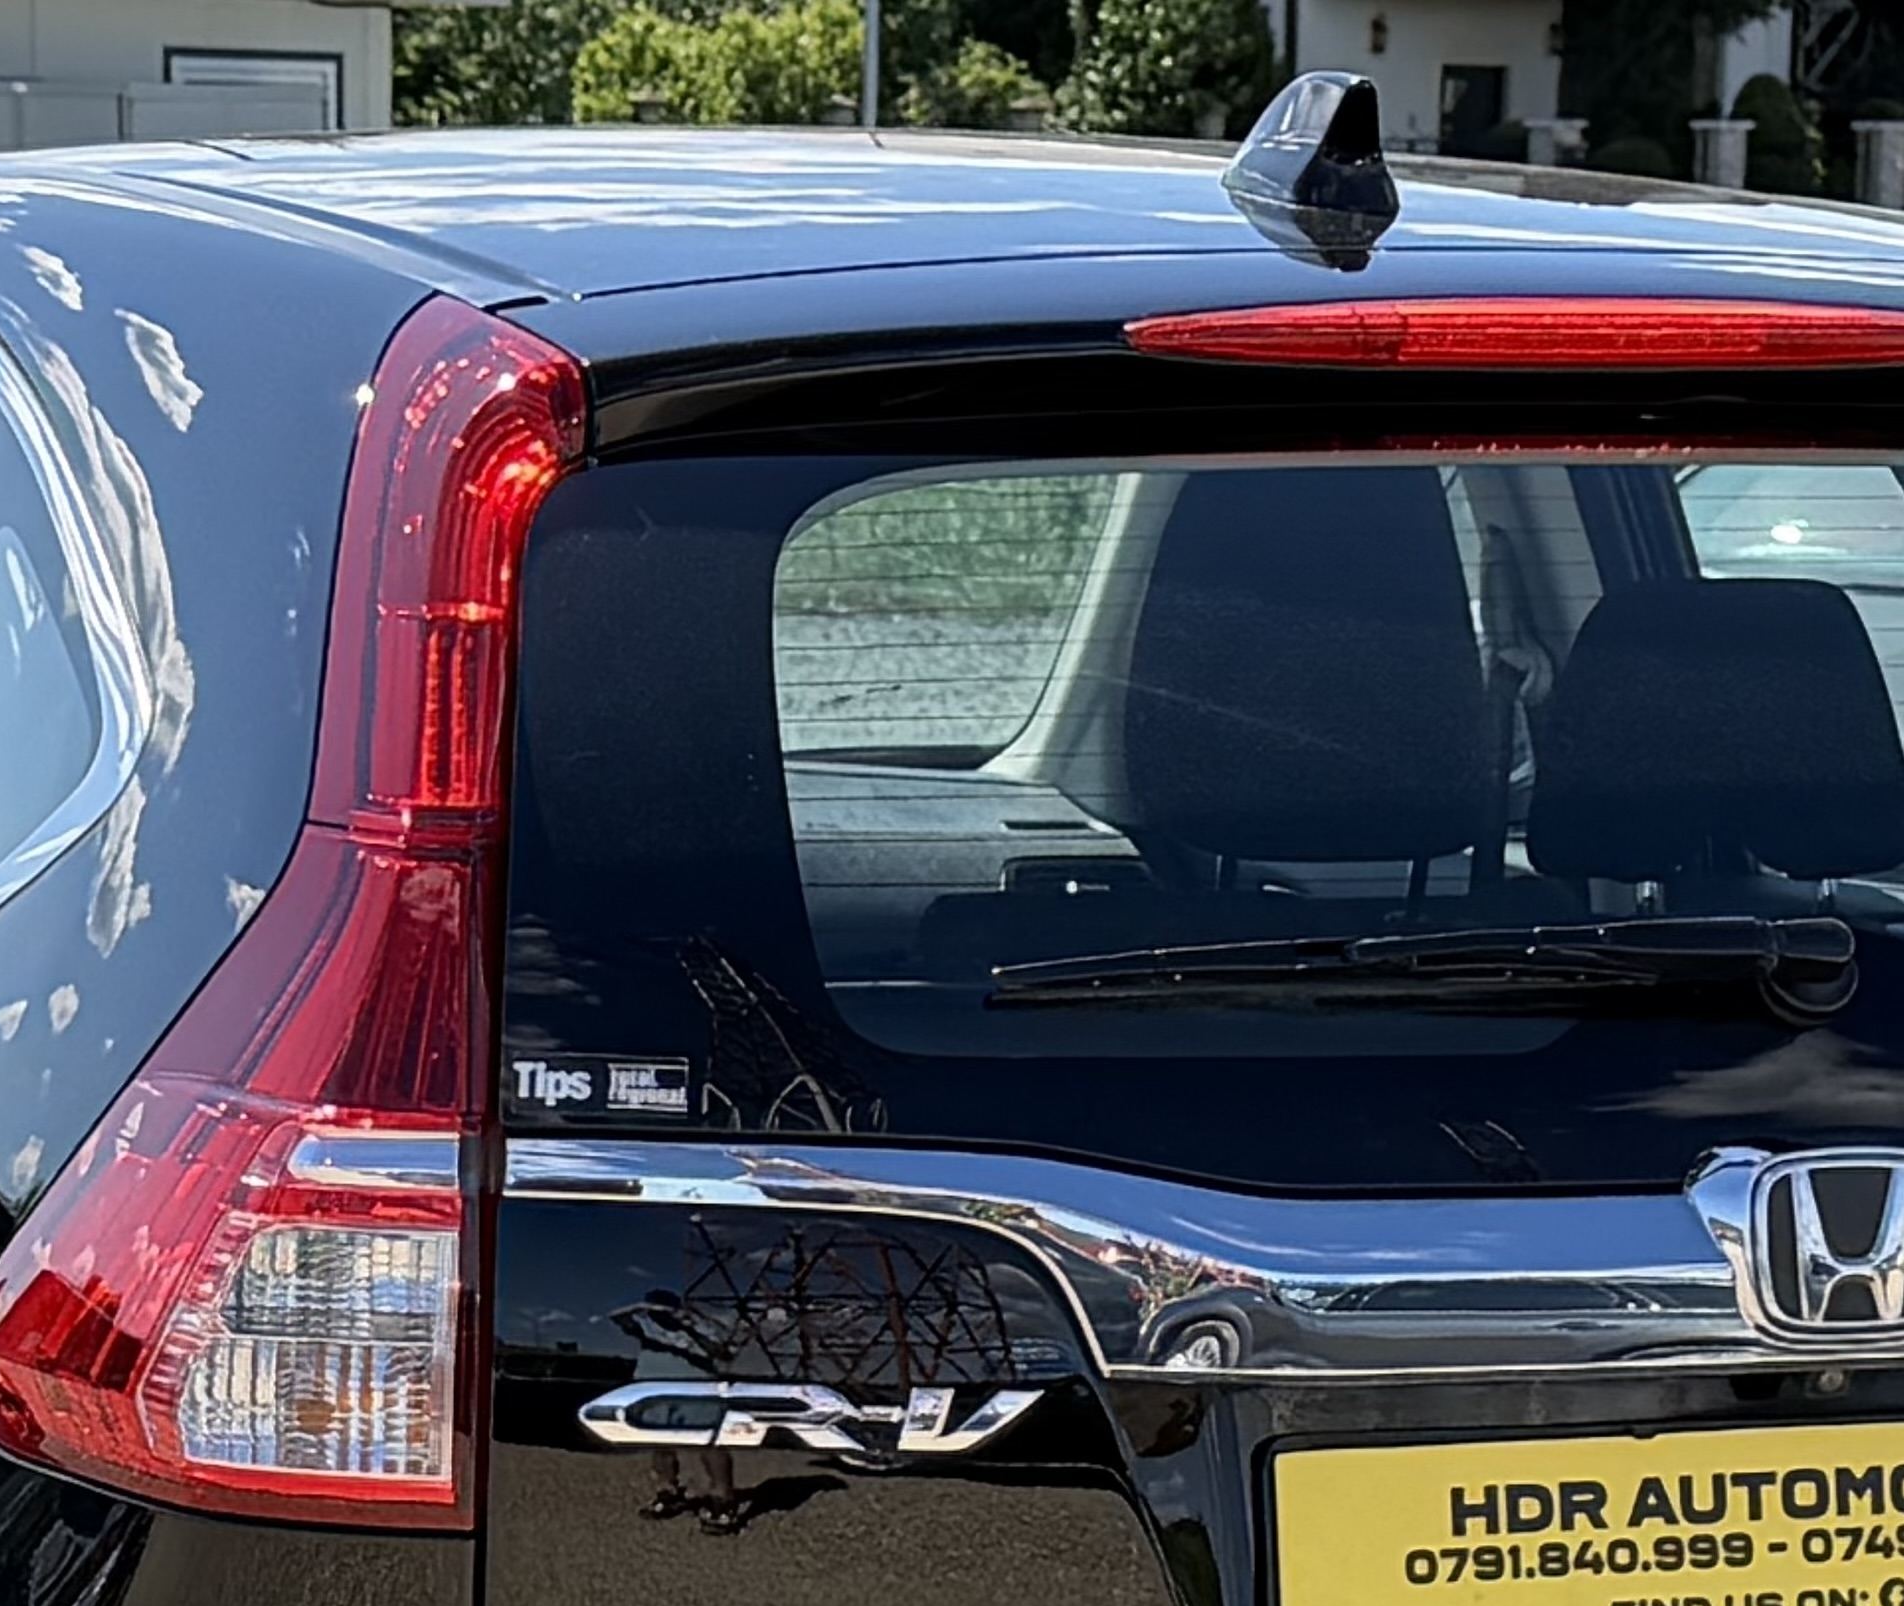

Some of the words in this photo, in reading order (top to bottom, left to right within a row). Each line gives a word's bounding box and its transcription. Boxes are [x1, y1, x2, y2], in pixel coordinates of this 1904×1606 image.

[578, 1380, 1046, 1452] CR-V
[1449, 1480, 1609, 1537] HDR
[1404, 1532, 1754, 1585] 0791.840.999
